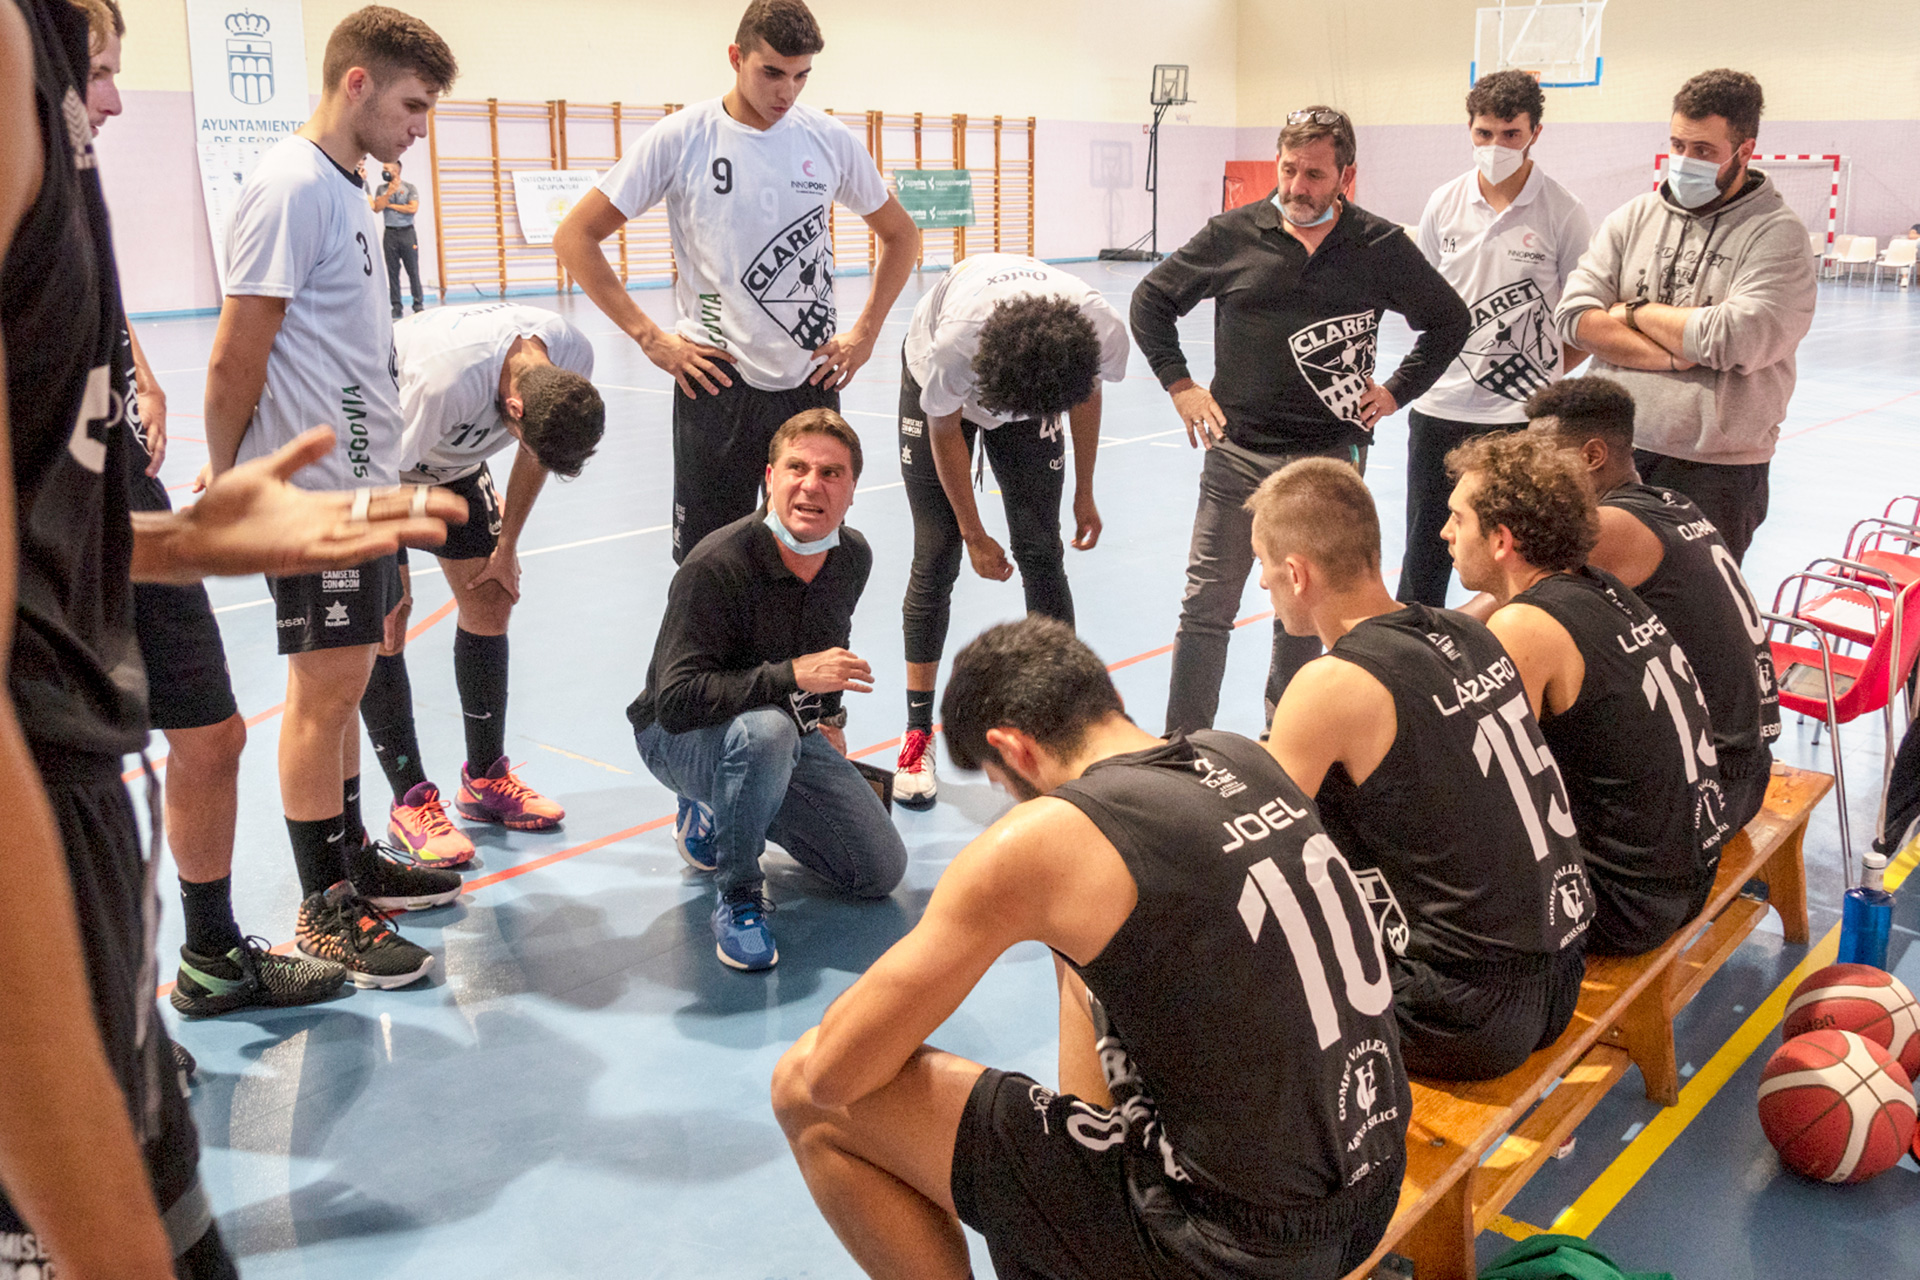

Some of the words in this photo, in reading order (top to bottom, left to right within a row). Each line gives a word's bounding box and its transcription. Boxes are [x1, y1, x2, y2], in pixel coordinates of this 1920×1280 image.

[712, 157, 733, 195] 9
[356, 231, 373, 277] 3
[748, 211, 824, 291] CLARET
[1292, 313, 1375, 354] CLARET
[1472, 283, 1533, 327] ARET
[342, 384, 370, 478] SEGOVIA
[322, 569, 360, 580] CAMISETAS
[1711, 544, 1766, 645] 0
[1617, 614, 1667, 653] LÓPE
[1432, 656, 1516, 716] LÁZARO
[1642, 643, 1718, 784] 13
[1472, 691, 1577, 862] 15
[1222, 796, 1308, 854] JOEL
[1237, 833, 1393, 1050] 10
